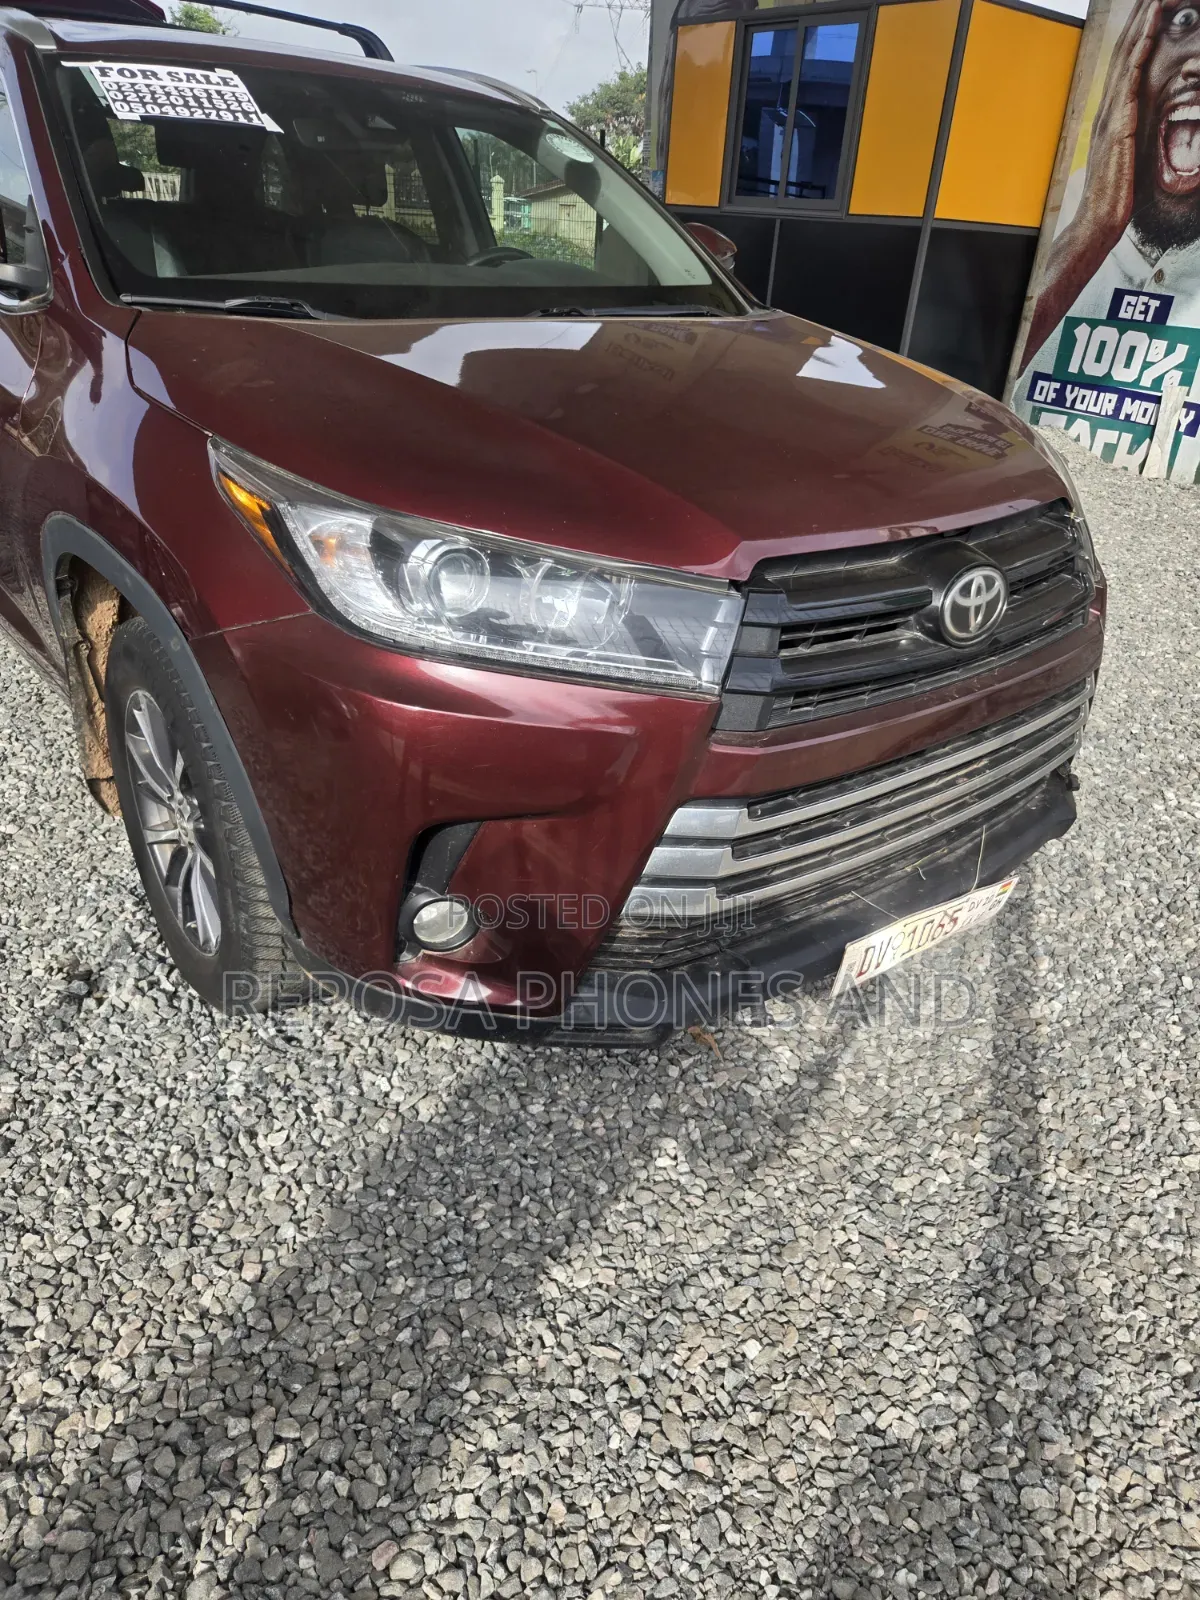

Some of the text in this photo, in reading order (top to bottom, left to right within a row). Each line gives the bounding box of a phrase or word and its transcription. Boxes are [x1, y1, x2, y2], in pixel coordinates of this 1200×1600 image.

[95, 66, 239, 88] FOR SALE
[103, 81, 250, 101] 0244436129
[110, 91, 256, 112] 0272011526
[116, 101, 262, 124] 0504927911
[1117, 294, 1161, 322] GET
[1067, 322, 1190, 391] 100%
[1033, 379, 1196, 432] OF YOUR MOY
[857, 907, 963, 978] DV 1065
